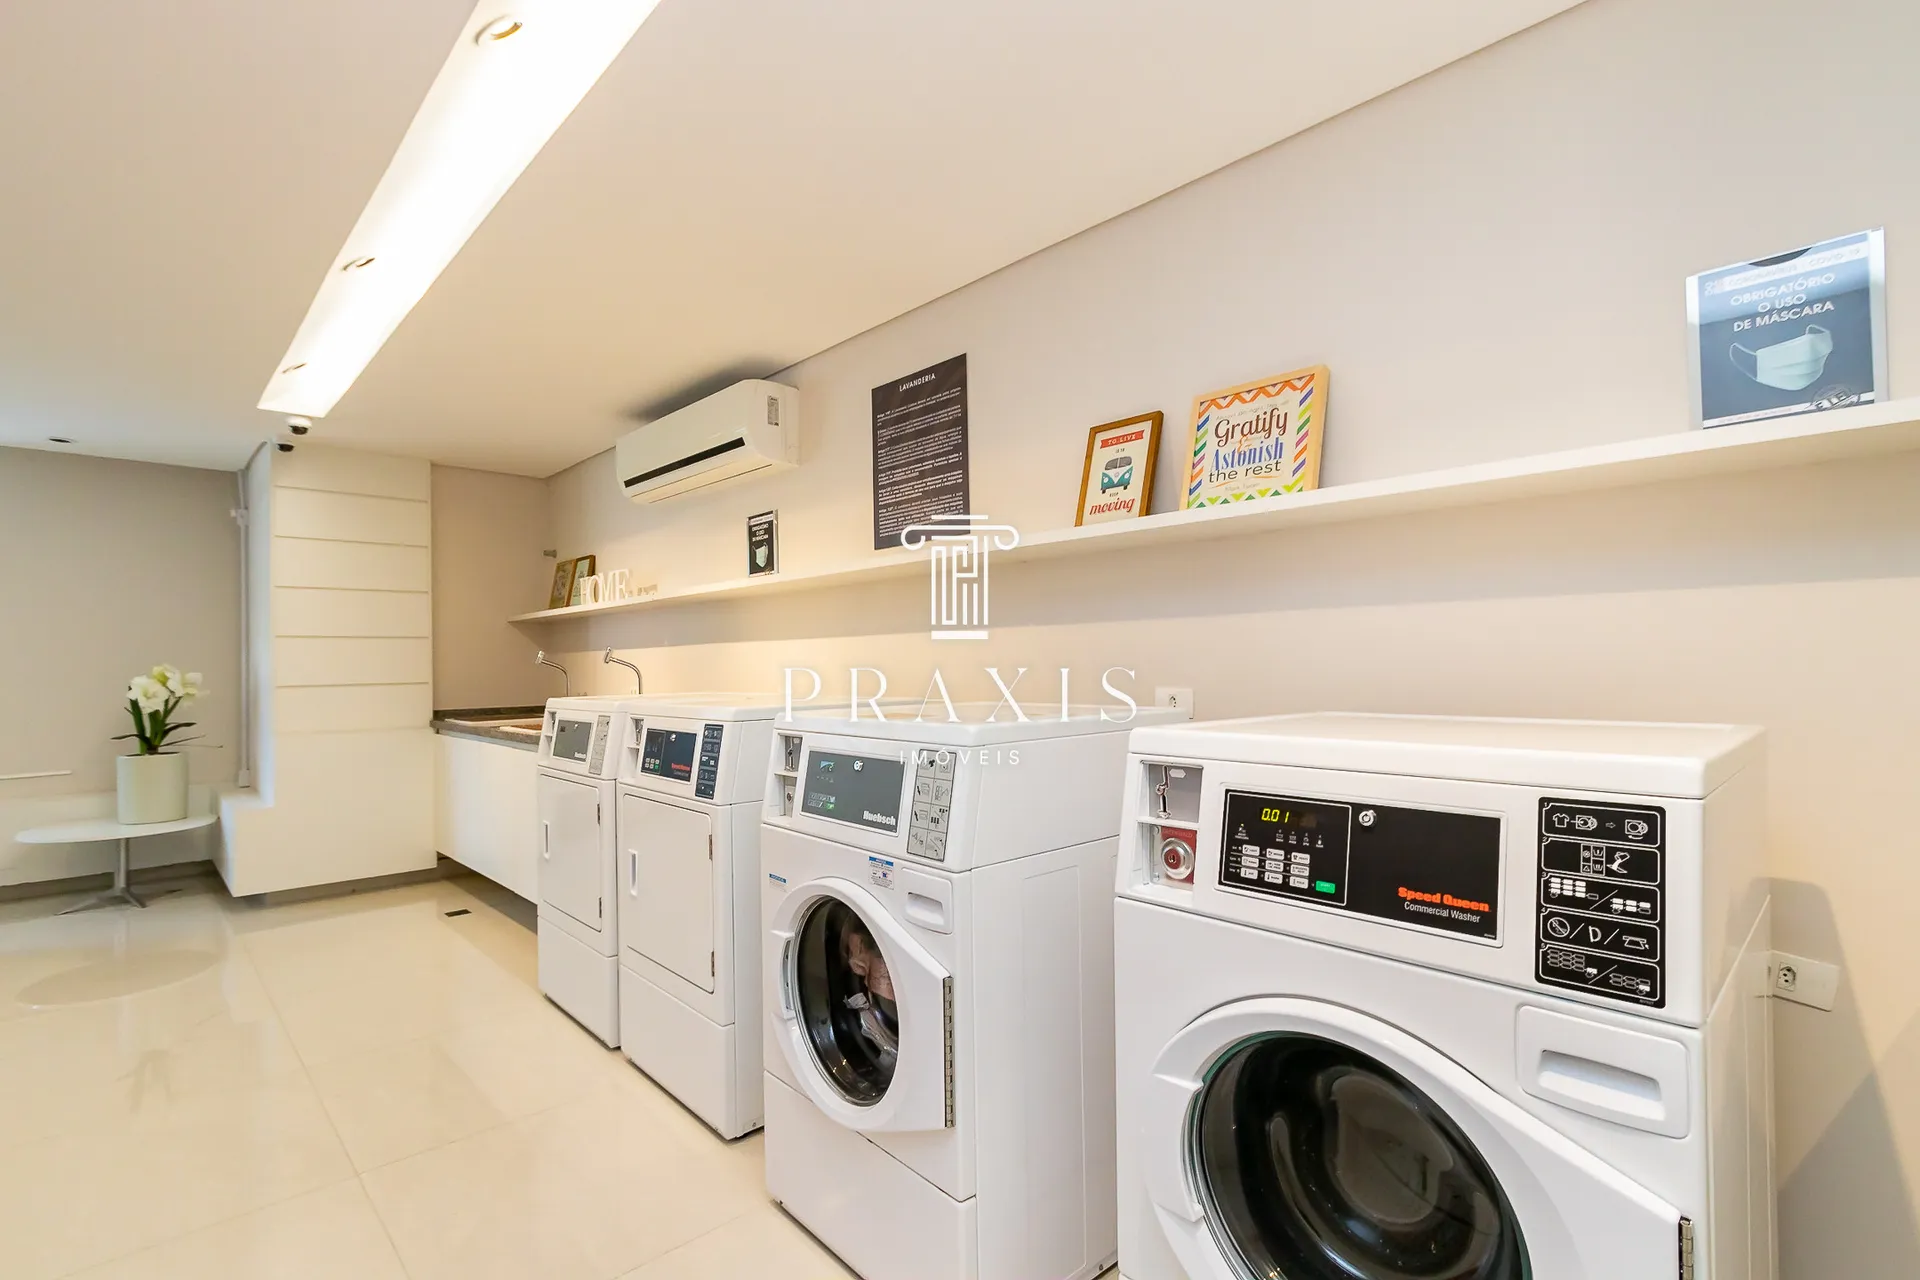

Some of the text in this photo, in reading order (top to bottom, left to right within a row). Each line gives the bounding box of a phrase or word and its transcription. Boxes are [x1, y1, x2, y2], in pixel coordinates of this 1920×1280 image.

[1730, 272, 1836, 306] OBRIGATÓRIO
[1757, 293, 1808, 313] O USO
[1733, 300, 1836, 333] DE MÁSCARA
[899, 372, 936, 392] LAVANDERIA
[1214, 407, 1289, 448] Gratify
[1209, 436, 1284, 473] Astonish
[1208, 459, 1282, 483] the rest
[1089, 497, 1136, 516] moving
[1398, 887, 1489, 912] Speed Queen
[1404, 901, 1481, 923] Commercial Washer
